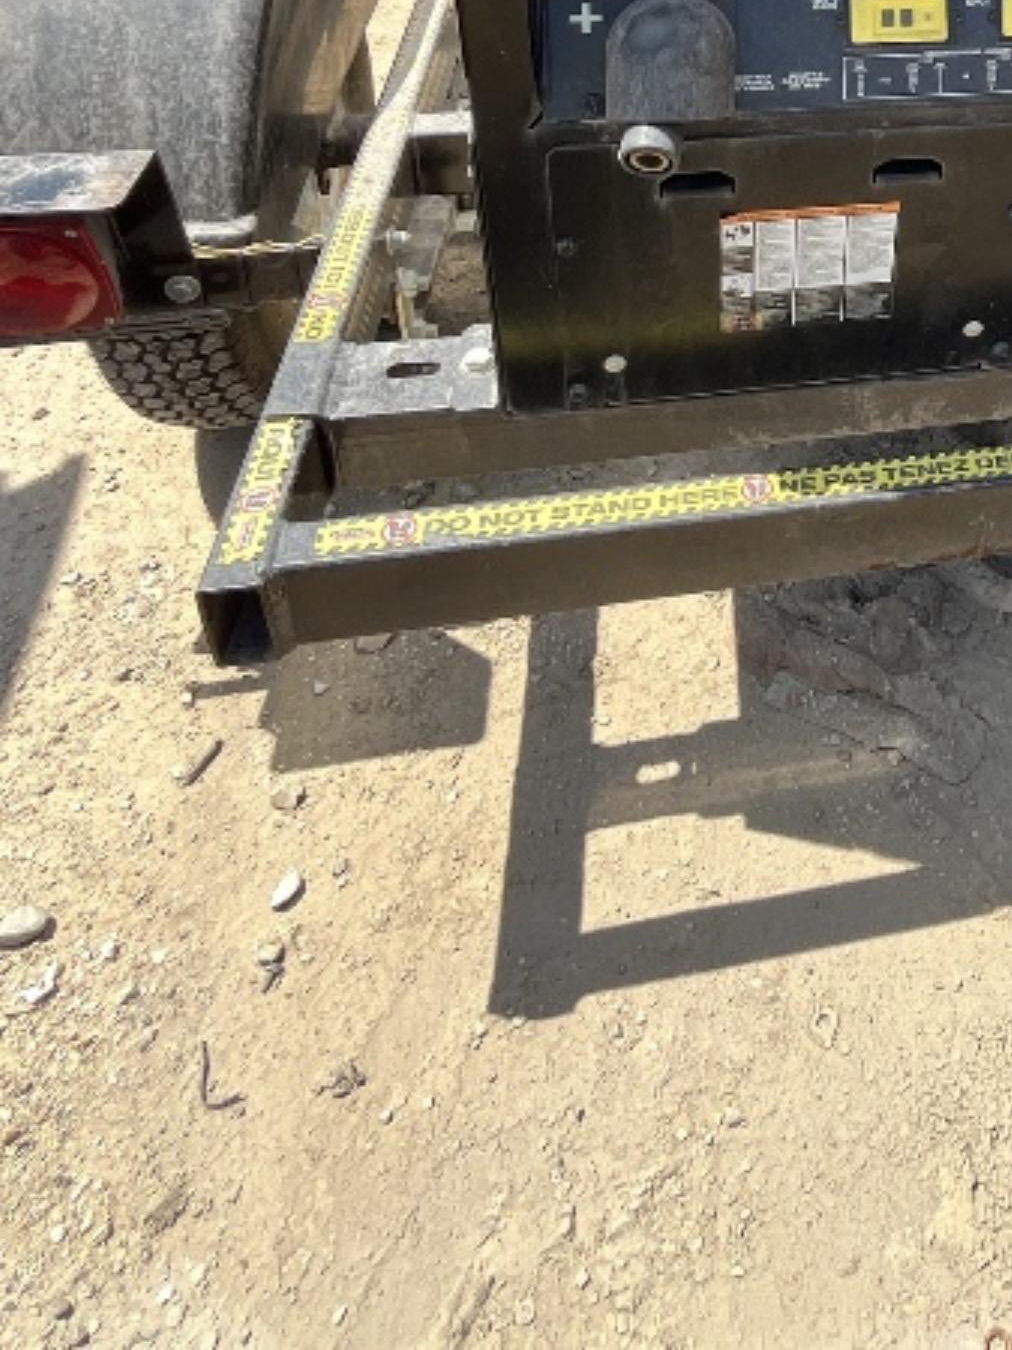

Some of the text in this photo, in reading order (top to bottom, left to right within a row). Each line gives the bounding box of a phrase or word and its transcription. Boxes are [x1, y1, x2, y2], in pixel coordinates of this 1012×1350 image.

[779, 475, 816, 493] NE
[824, 469, 876, 488] PAS
[882, 458, 970, 482] TENEZ
[425, 486, 739, 533] DO NOT STAND HERE
